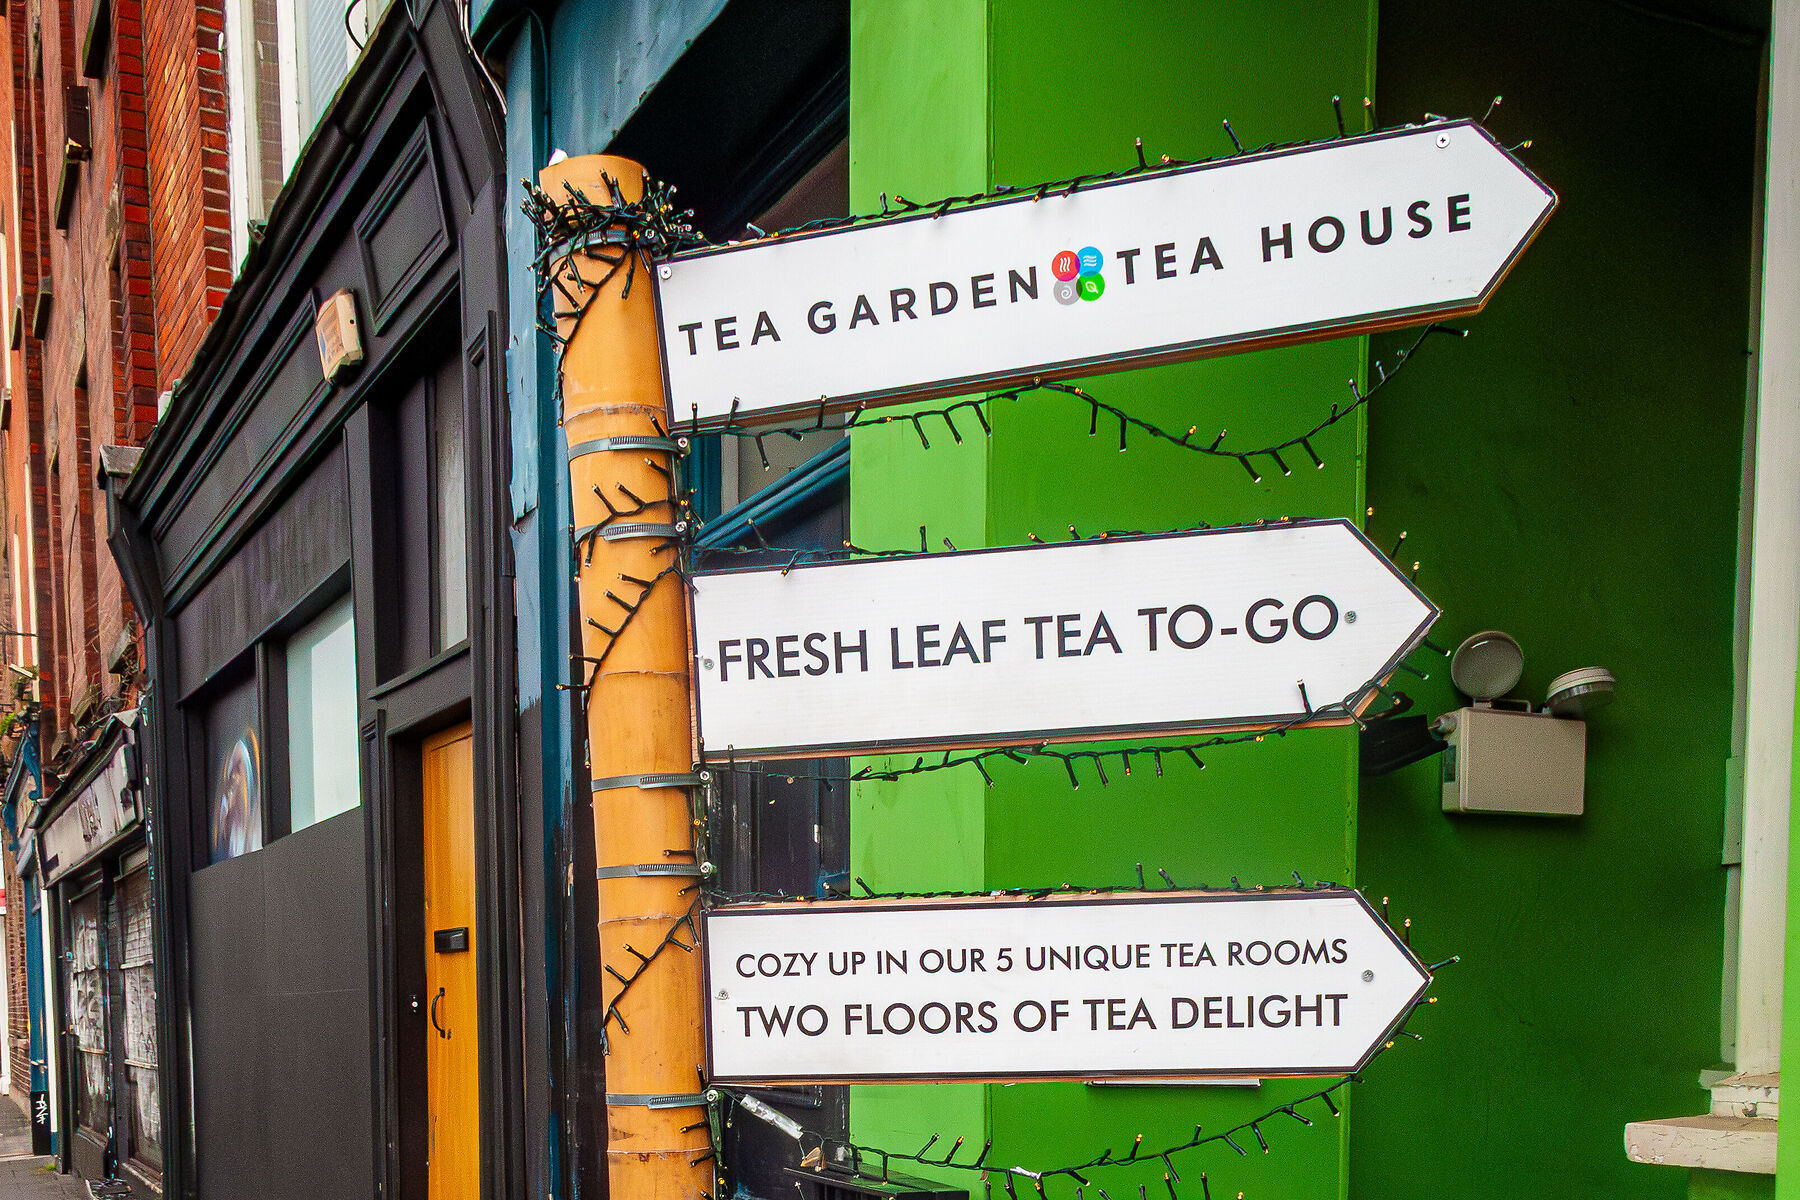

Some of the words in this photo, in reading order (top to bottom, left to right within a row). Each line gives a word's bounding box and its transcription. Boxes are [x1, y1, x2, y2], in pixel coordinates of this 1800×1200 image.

[677, 310, 782, 356] TEA
[807, 265, 1039, 336] GARDEN
[1116, 236, 1224, 286] TEA
[1260, 193, 1471, 264] HOUSE
[718, 629, 869, 682] FRESH
[890, 619, 1007, 670] LEAF
[1023, 610, 1123, 661] TEA
[1137, 594, 1339, 652] TO-GO
[735, 952, 818, 979] COZY
[828, 951, 866, 976] UP
[876, 949, 908, 975] IN
[919, 948, 987, 974] OUR
[996, 947, 1013, 973] 5
[1025, 943, 1150, 972] UNIQUE
[1160, 941, 1217, 968] TEA
[1227, 938, 1348, 966] ROOMS
[736, 1004, 829, 1038] TWO
[844, 1000, 998, 1036] FLOORS
[1013, 999, 1070, 1033] OF
[1082, 997, 1158, 1031] TEA
[1171, 993, 1349, 1030] DELIGHT
